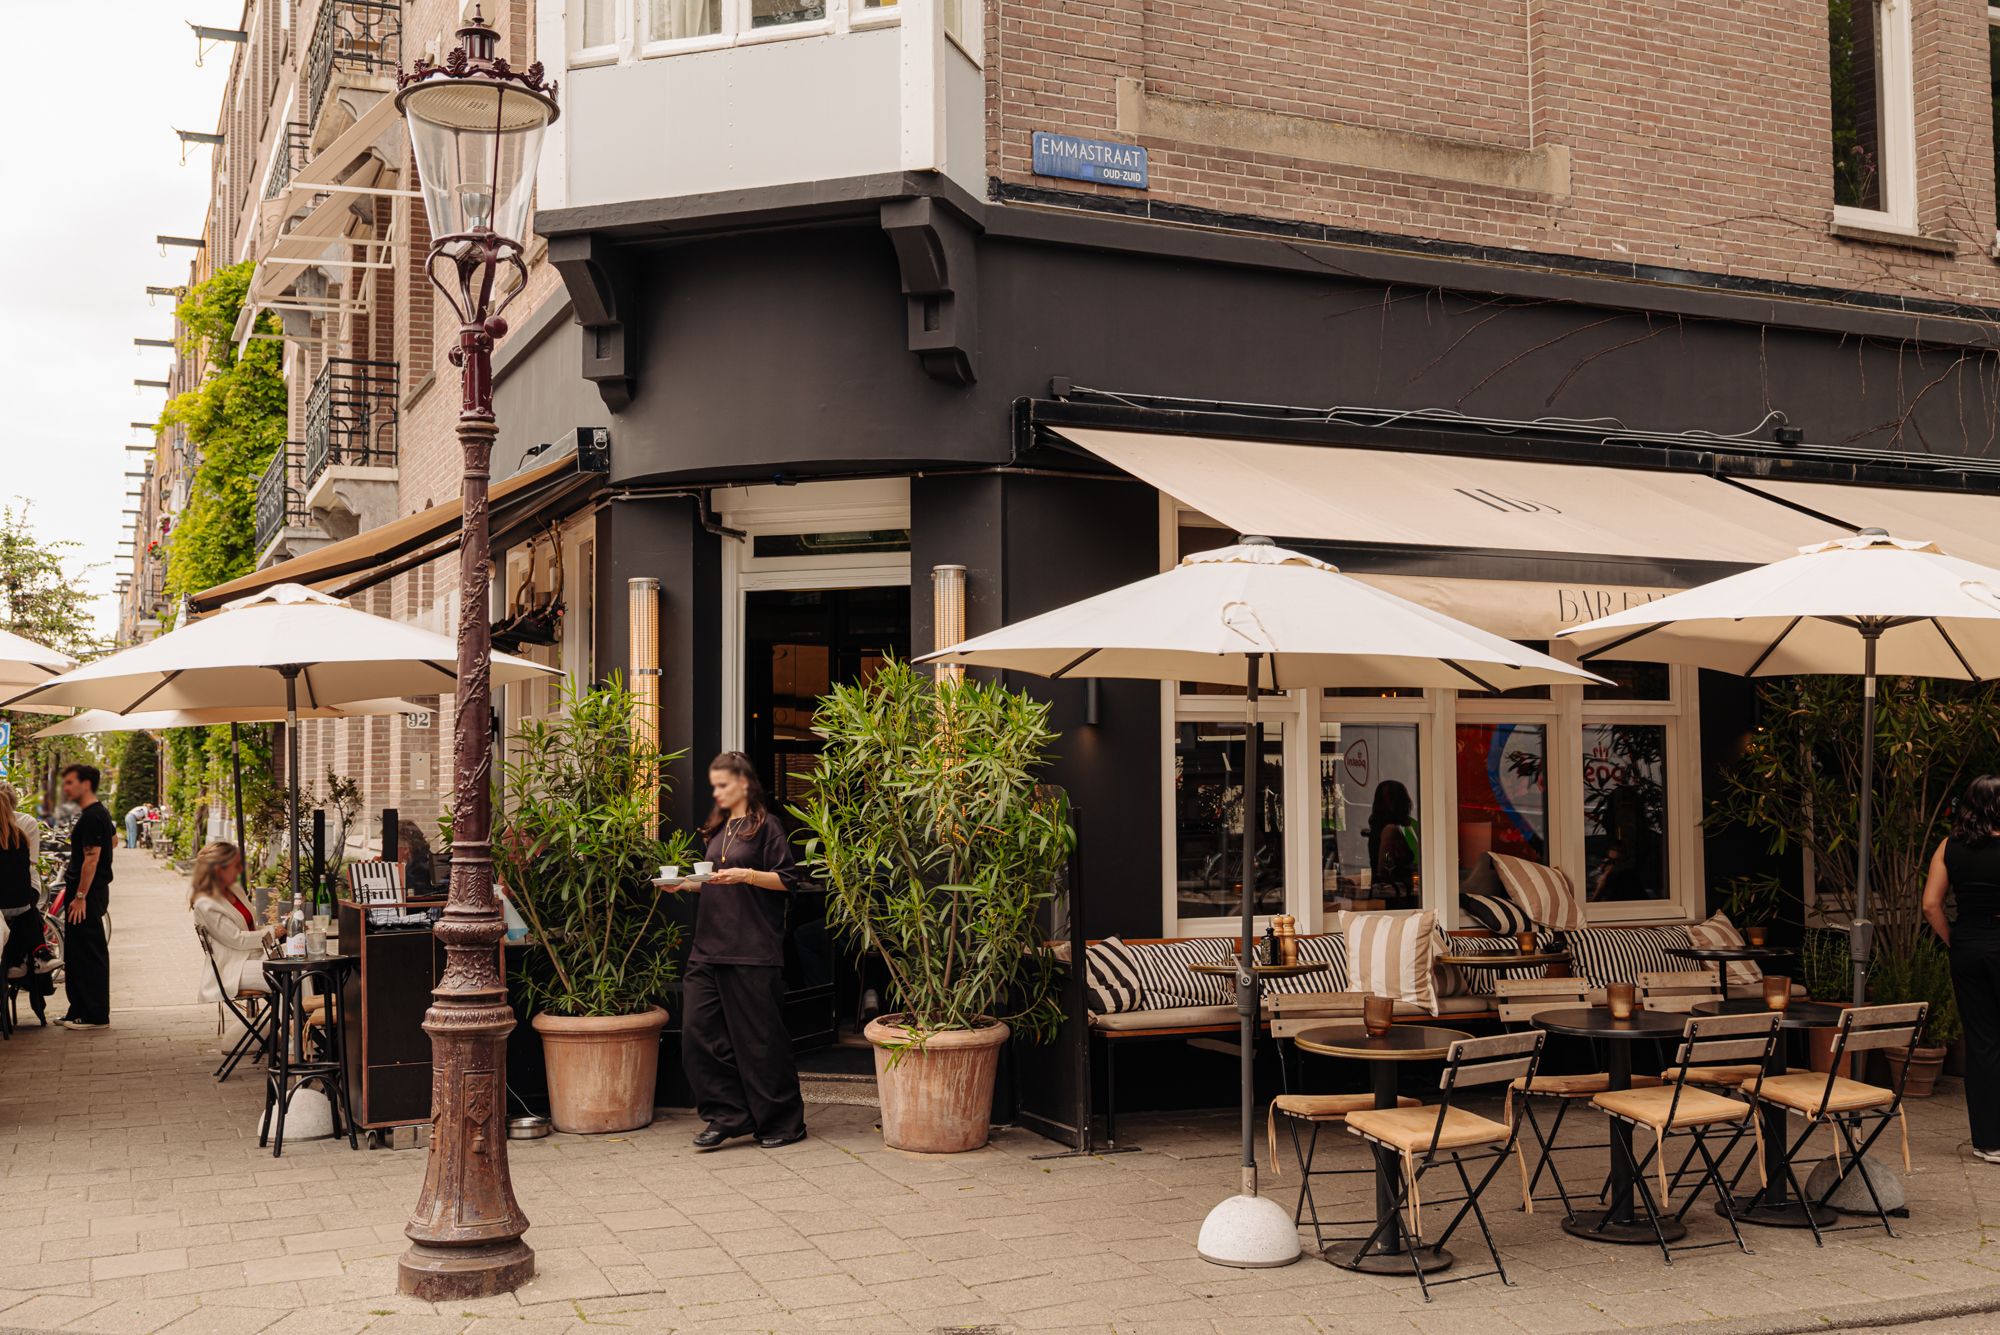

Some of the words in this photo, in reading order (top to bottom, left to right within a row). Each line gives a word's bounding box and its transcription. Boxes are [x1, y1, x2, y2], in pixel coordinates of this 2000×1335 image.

[1041, 137, 1141, 167] EMMASTRAAT
[1103, 168, 1141, 182] OUD-ZUID
[1558, 589, 1611, 623] BAR
[408, 712, 429, 728] 92
